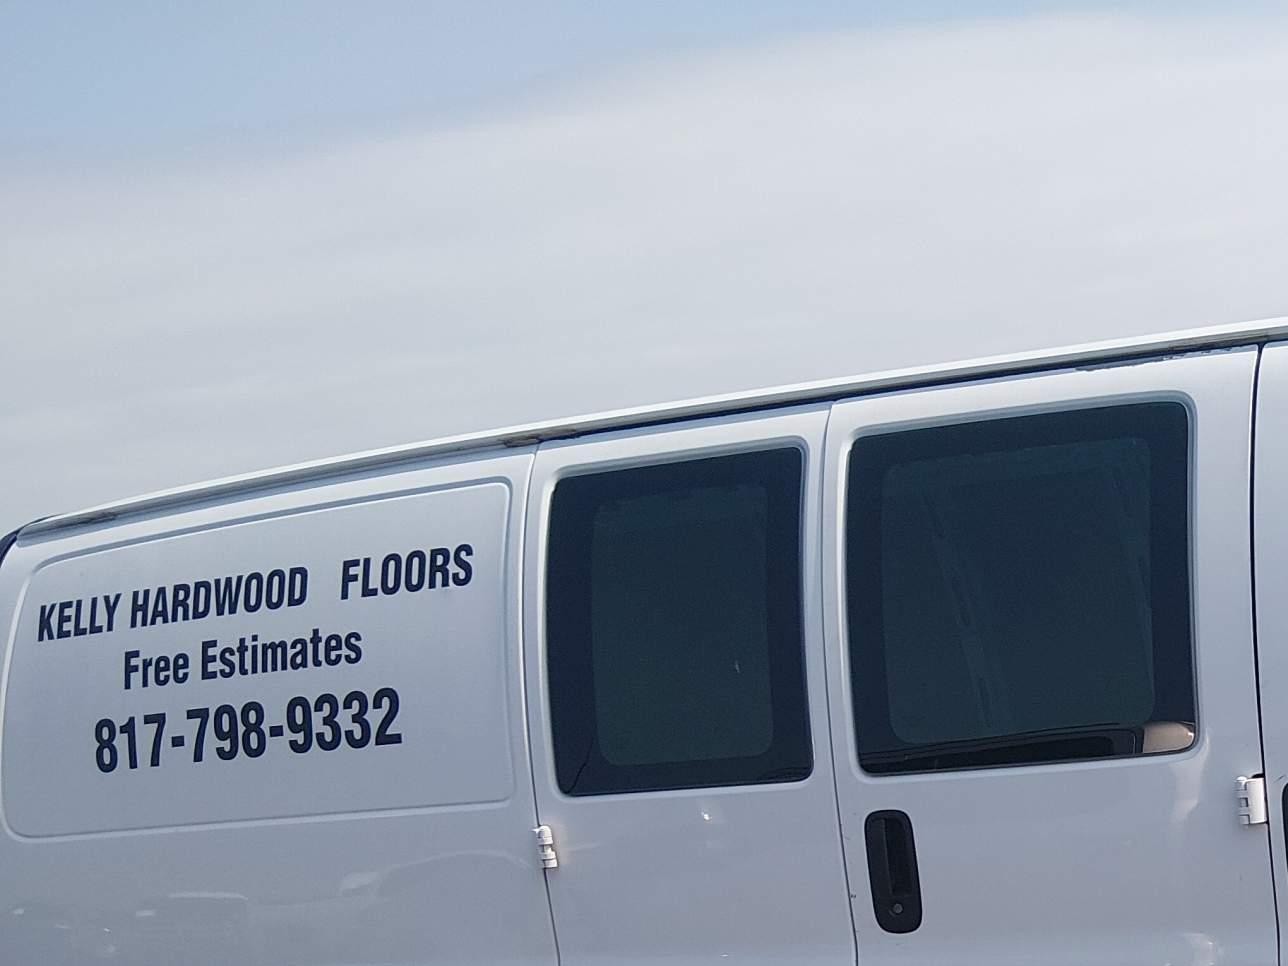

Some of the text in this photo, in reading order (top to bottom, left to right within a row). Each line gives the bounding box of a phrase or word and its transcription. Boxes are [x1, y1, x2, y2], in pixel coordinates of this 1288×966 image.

[37, 543, 474, 643] KELLY HARDWOOD FLOORS
[123, 628, 363, 691] Free Estimates
[94, 687, 403, 774] 817-798-9332
